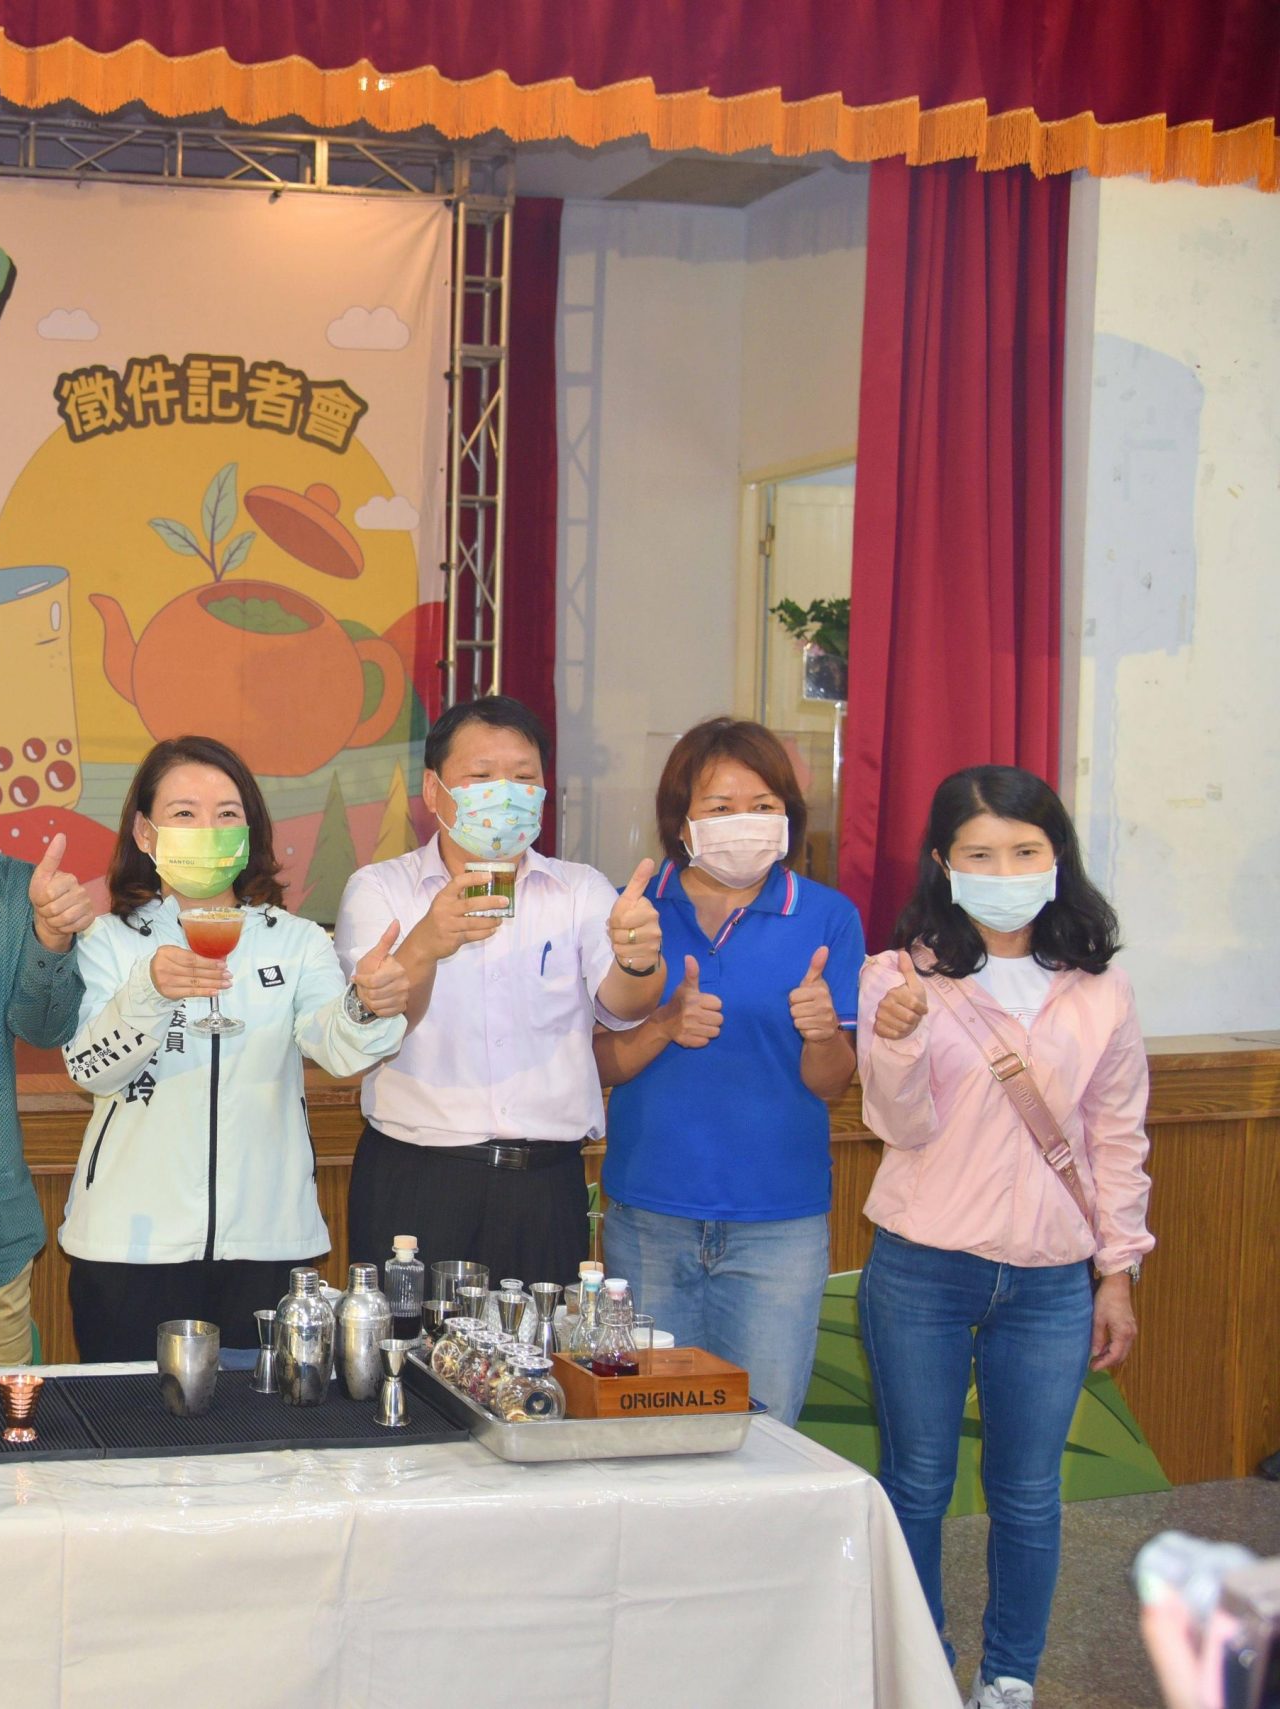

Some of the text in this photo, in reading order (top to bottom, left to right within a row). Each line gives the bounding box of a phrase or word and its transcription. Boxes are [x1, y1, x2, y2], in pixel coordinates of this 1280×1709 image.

[60, 360, 362, 448] 徵件記者會
[620, 1389, 726, 1410] ORIGINALS
